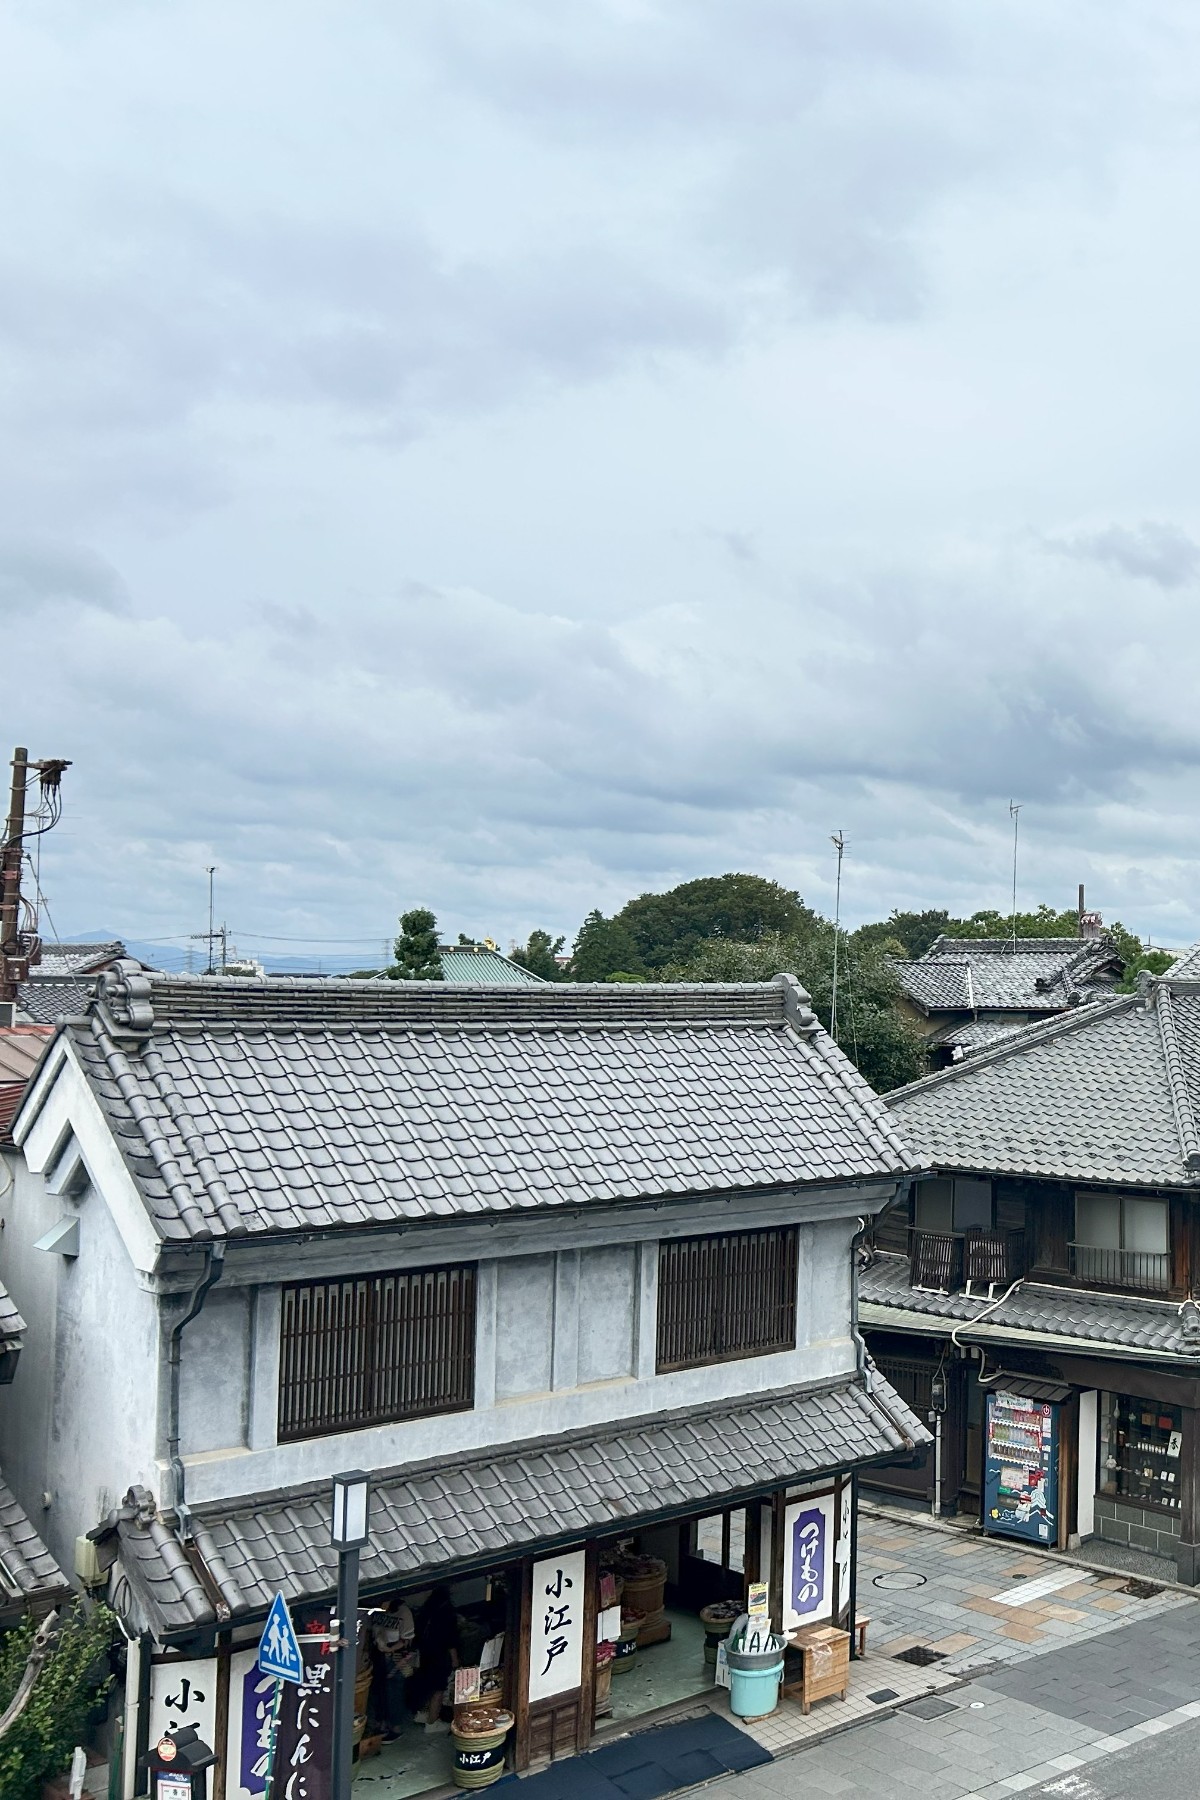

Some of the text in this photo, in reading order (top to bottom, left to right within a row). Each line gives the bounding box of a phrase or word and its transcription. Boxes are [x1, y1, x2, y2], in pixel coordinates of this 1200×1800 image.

[797, 1522, 820, 1603] つけもの
[540, 1568, 573, 1677] 小江戸
[459, 1751, 492, 1765] 小江戸
